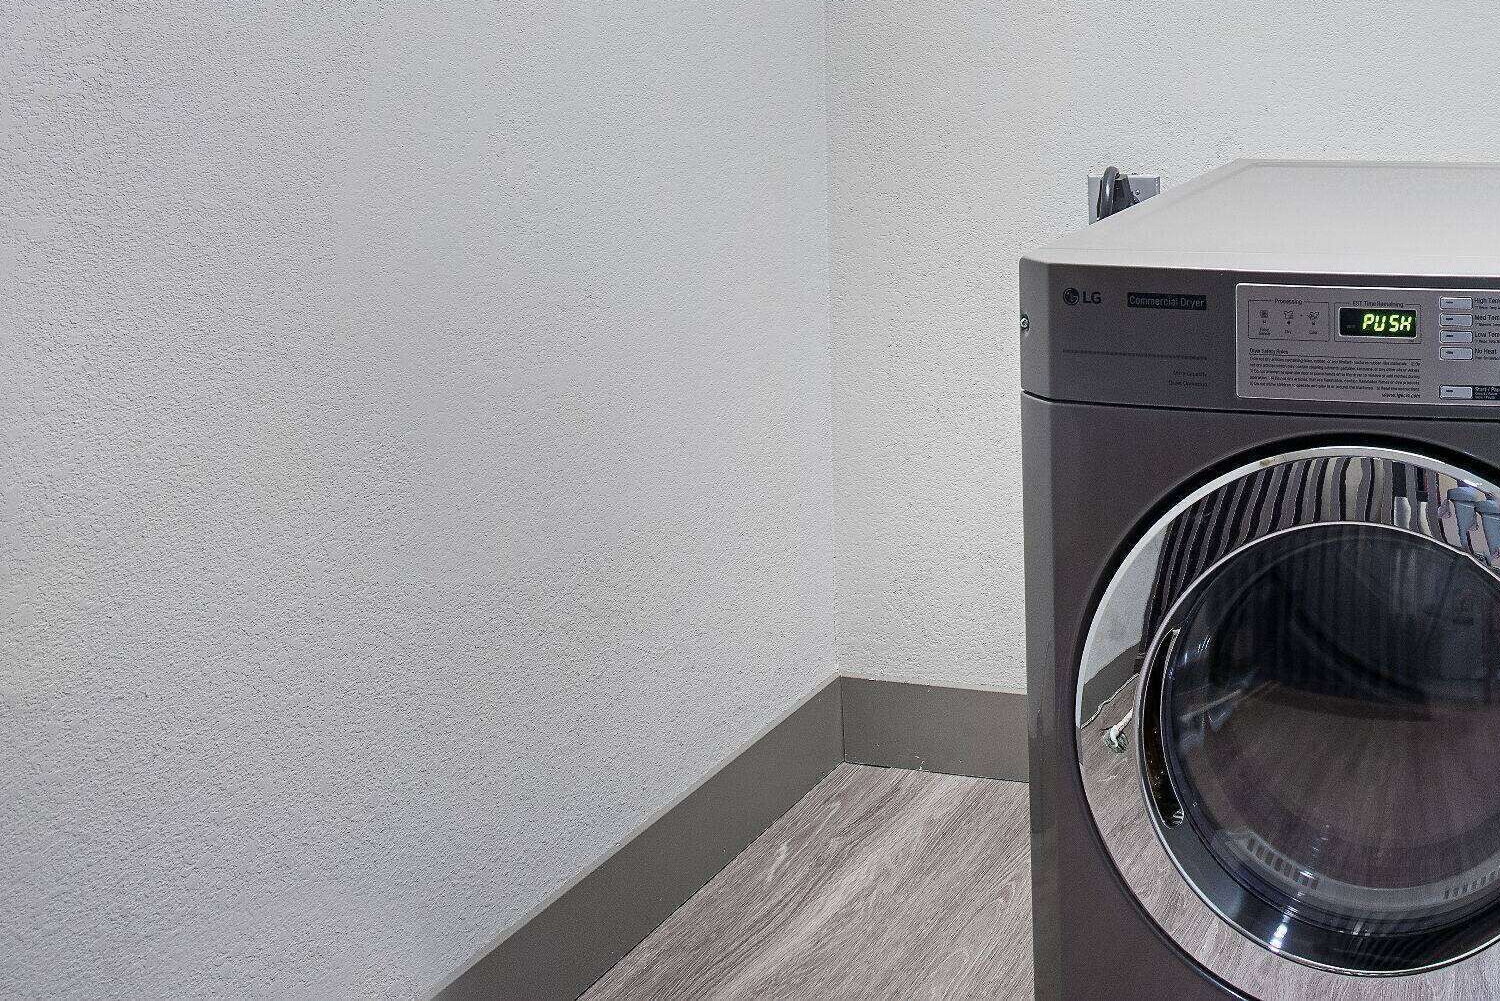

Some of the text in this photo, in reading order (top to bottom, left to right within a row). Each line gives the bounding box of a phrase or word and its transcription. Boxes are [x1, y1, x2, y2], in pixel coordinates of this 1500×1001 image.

[1082, 291, 1101, 304] LG
[1129, 295, 1205, 310] Commercial Dryer
[1362, 313, 1412, 332] PUSH
